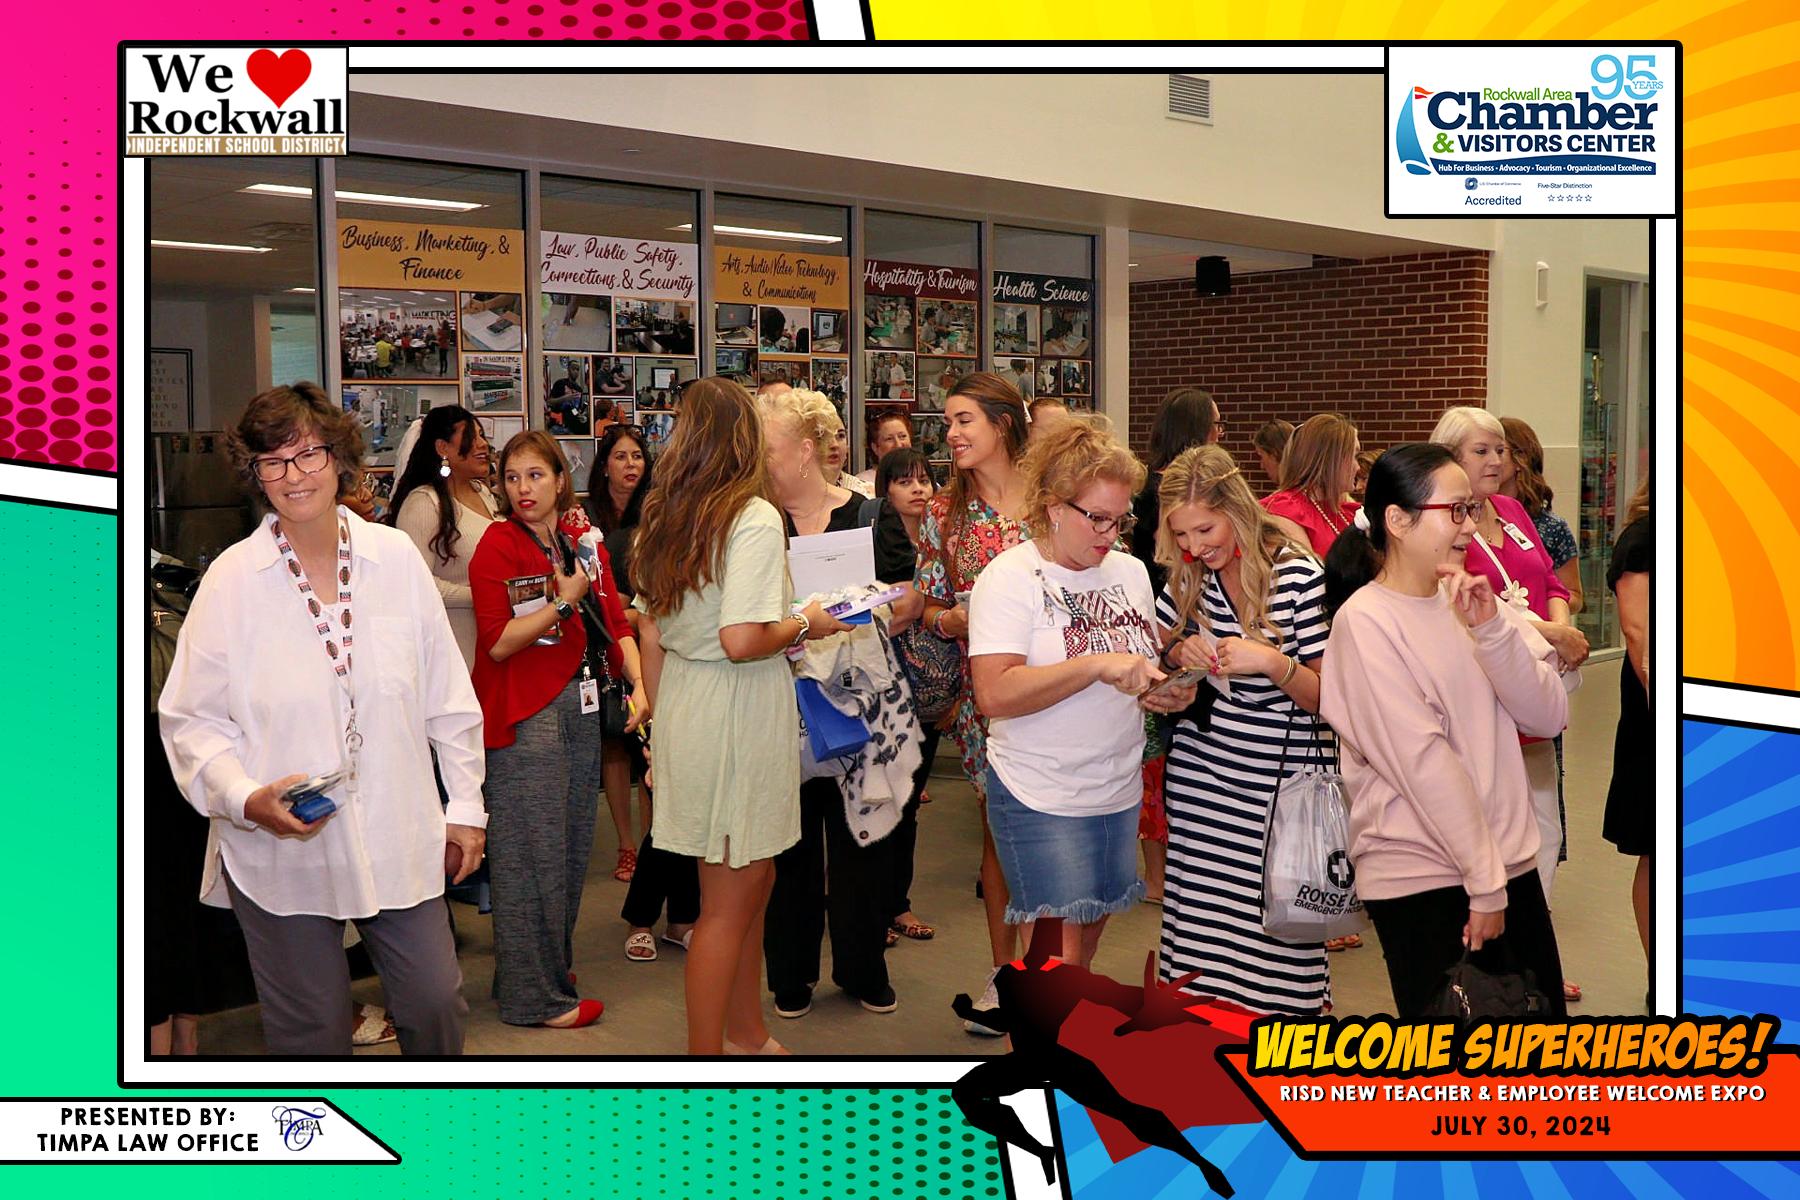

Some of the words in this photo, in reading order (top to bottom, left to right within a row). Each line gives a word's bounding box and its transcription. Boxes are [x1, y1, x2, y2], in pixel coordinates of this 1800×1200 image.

[342, 225, 408, 250] Business,
[415, 229, 495, 261] Marketing,
[498, 235, 510, 254] &
[545, 234, 579, 259] Law,
[585, 237, 628, 261] Public
[633, 242, 683, 272] Safety,
[399, 257, 464, 281] Finance
[864, 261, 926, 295] Hospitality
[927, 270, 937, 288] &
[937, 268, 977, 295] Tourism
[622, 269, 634, 290] &
[637, 268, 695, 299] Security
[742, 282, 752, 297] &
[758, 279, 816, 303] Communications
[993, 275, 1038, 300] Health
[1041, 279, 1090, 302] Science
[1294, 899, 1344, 915] EMERGENCY
[1296, 884, 1348, 907] ROYSE
